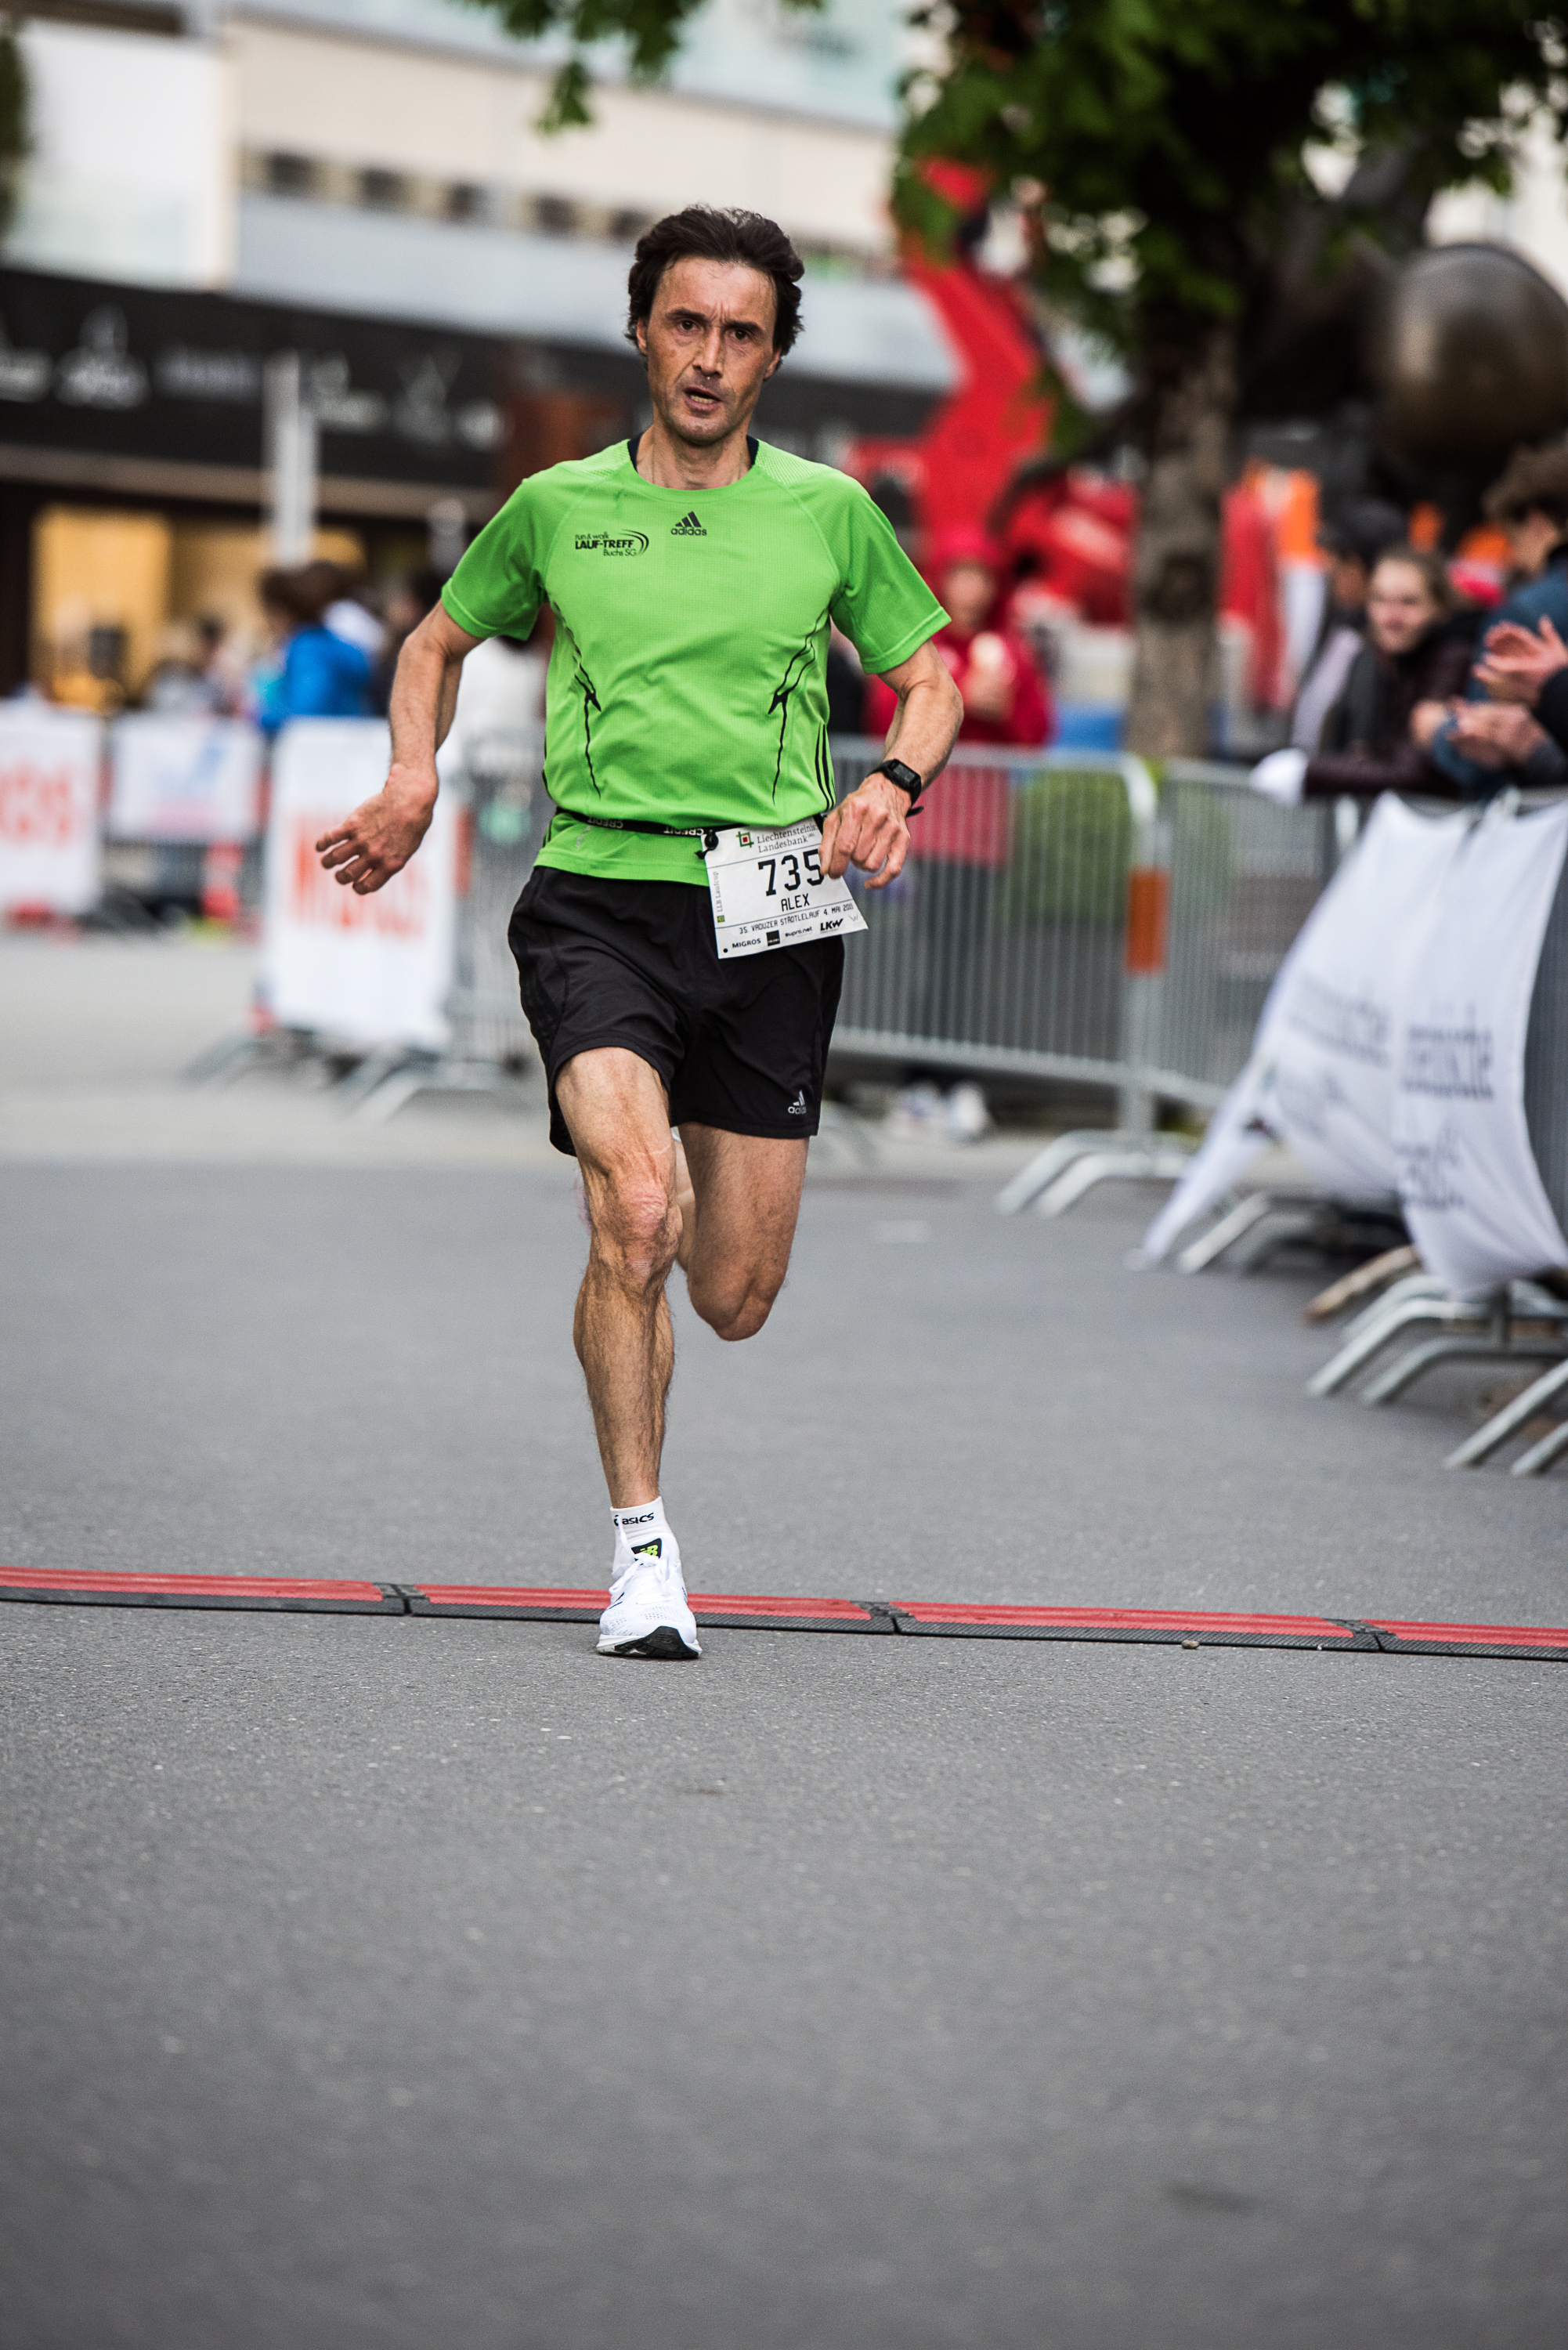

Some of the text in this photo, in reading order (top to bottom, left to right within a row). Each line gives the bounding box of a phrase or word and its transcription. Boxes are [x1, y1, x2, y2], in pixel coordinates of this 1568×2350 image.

[671, 527, 707, 537] adidas
[575, 540, 634, 549] LAUF-TREFF
[758, 835, 808, 853] Landesbank
[758, 848, 825, 896] 735
[713, 871, 721, 898] Laufcup
[781, 893, 810, 912] ALEX
[831, 906, 841, 914] MAI
[820, 918, 844, 931] LKW
[732, 938, 761, 949] MIGROS
